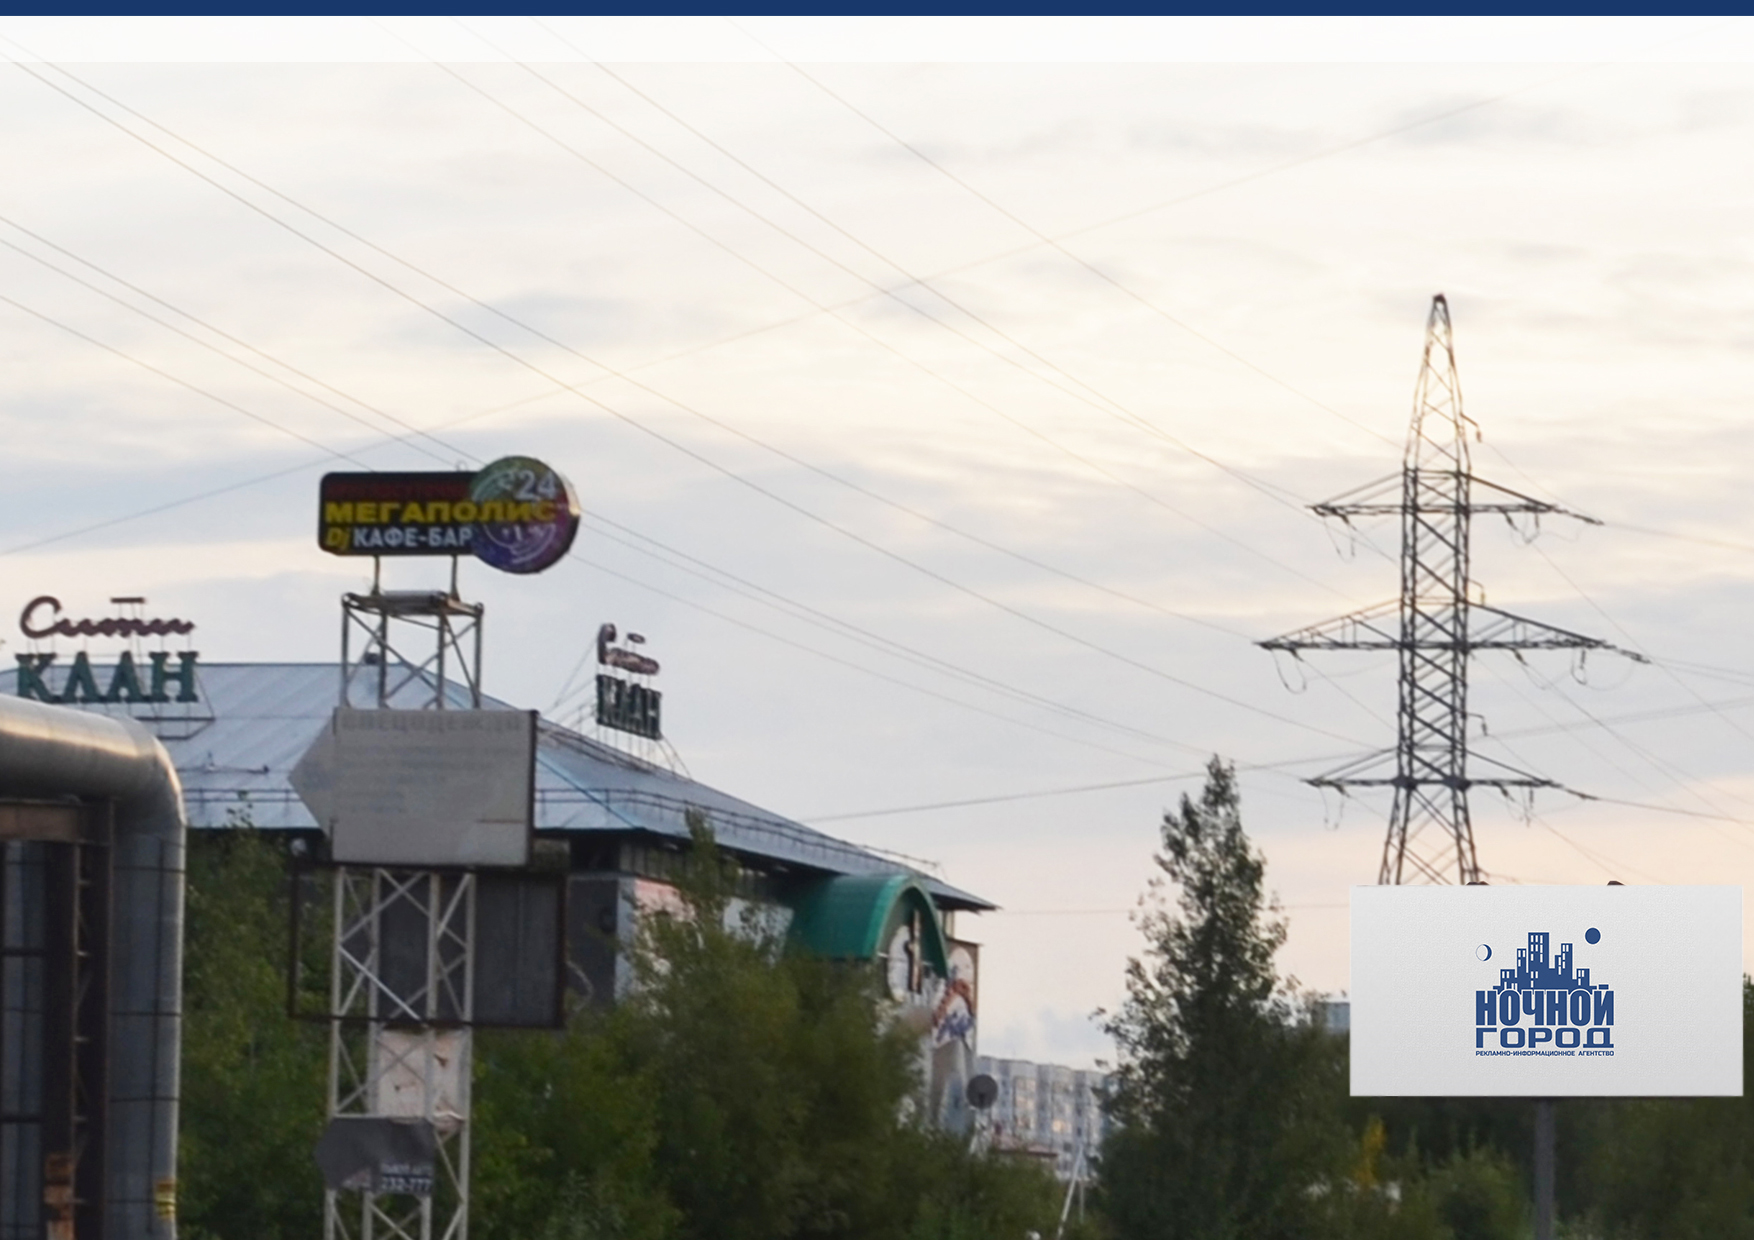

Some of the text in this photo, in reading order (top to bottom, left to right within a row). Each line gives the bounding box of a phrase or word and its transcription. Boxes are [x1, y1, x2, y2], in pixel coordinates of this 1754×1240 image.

[514, 469, 557, 500] 24
[325, 501, 557, 524] МЕГАПОЛИС
[353, 526, 474, 548] КАФЕ-БАР
[14, 651, 200, 704] КЛАН
[1475, 984, 1615, 1026] НОЧНОЙ
[1475, 1027, 1615, 1049] ГОРОД
